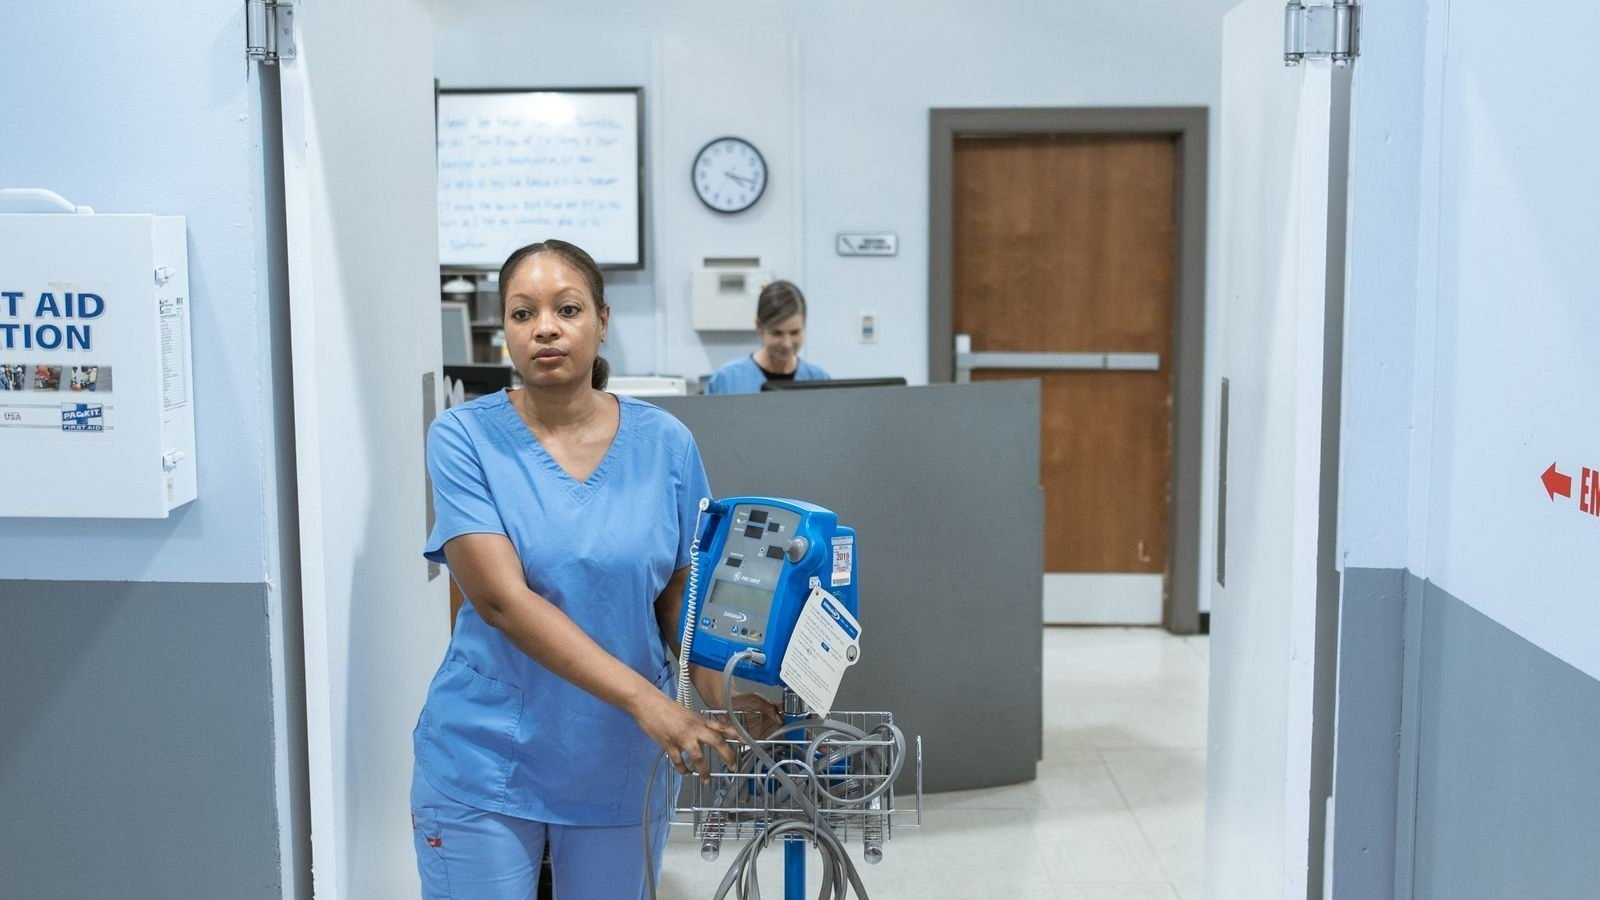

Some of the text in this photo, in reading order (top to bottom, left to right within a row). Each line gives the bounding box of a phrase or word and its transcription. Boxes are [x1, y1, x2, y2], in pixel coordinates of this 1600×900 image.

[35, 292, 105, 319] AID
[0, 323, 91, 350] TION
[3, 411, 22, 421] USA
[836, 552, 850, 561] 2019
